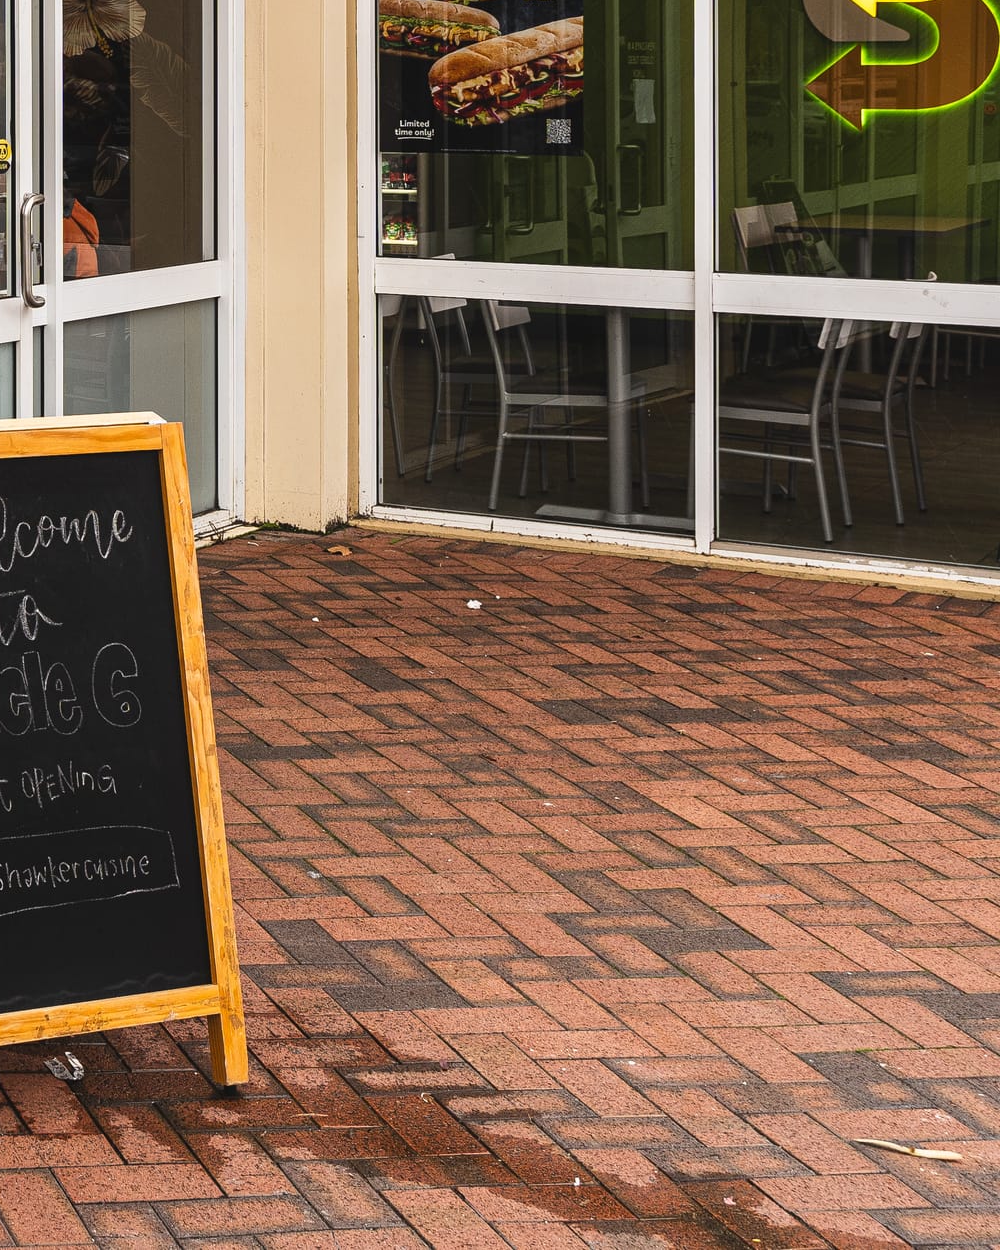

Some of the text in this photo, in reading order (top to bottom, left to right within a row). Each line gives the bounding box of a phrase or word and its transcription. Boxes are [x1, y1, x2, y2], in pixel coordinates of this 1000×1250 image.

[399, 119, 430, 128] Limited
[394, 128, 435, 138] time only!
